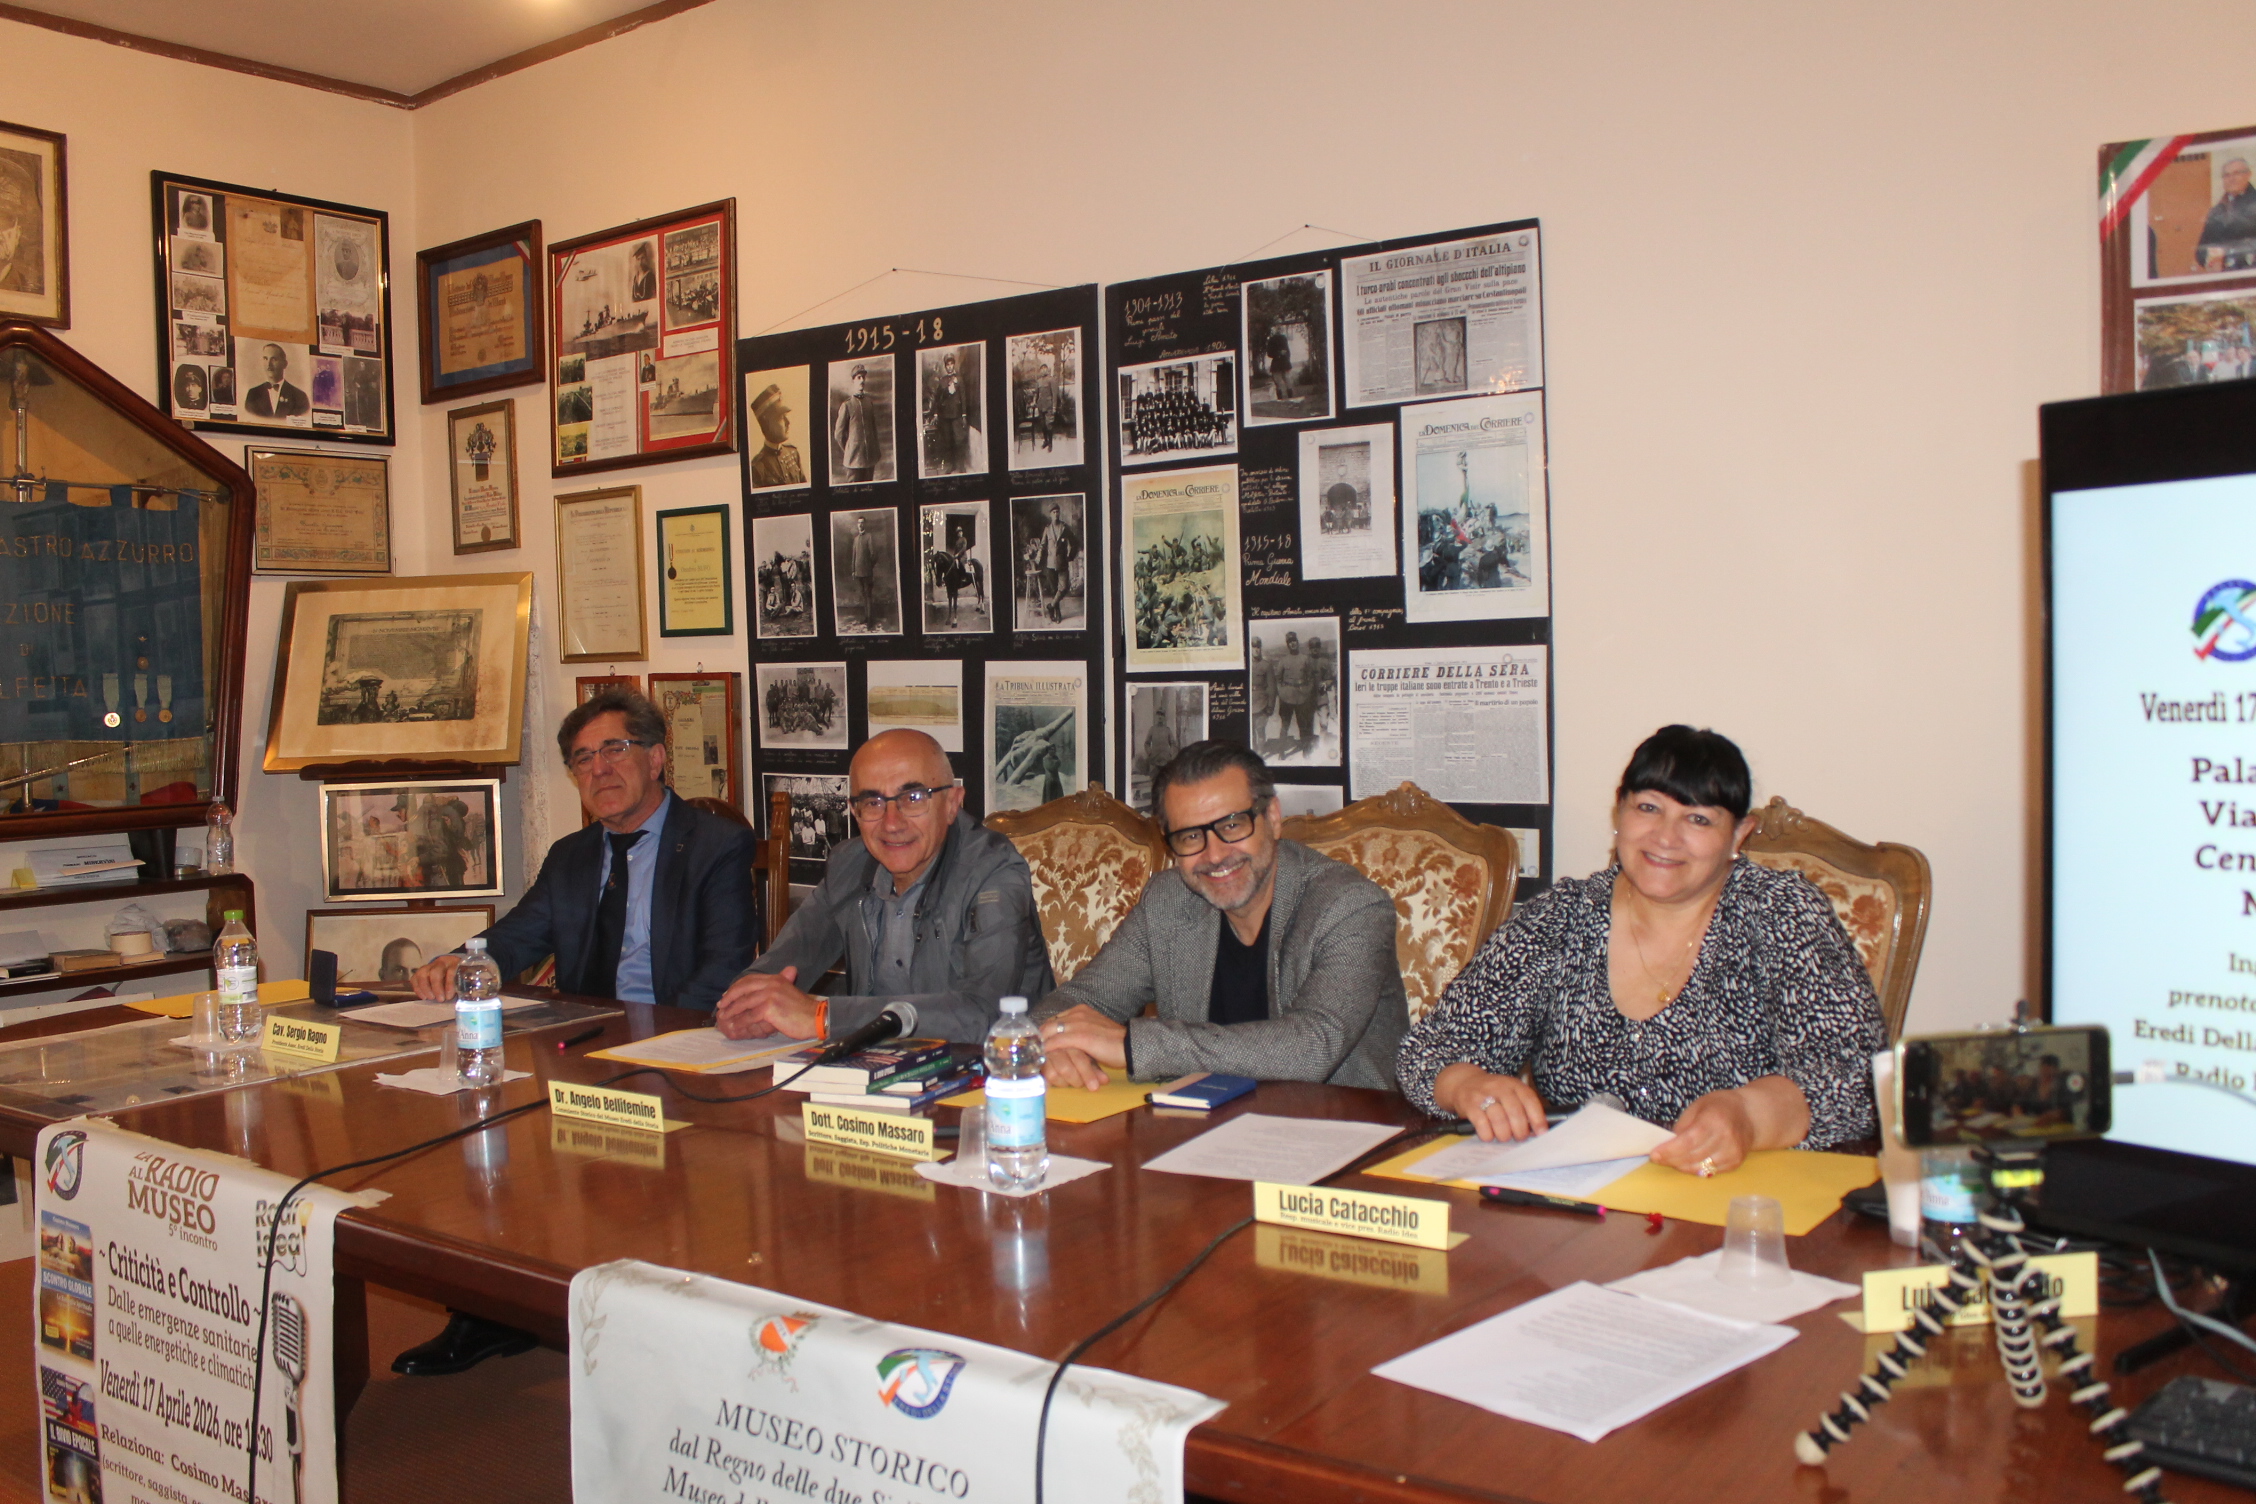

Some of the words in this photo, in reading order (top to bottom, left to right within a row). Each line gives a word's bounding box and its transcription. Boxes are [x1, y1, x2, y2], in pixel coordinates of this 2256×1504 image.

[1369, 261, 1382, 272] IL
[1386, 250, 1450, 270] GIORNALE
[1454, 242, 1512, 261] D'ITALIA
[1374, 293, 1409, 304] autentiche
[80, 540, 195, 564] AZZURRO
[1242, 552, 1265, 566] Prima
[1267, 552, 1294, 571] Guerra
[1245, 569, 1292, 586] Mondiale
[1355, 681, 1368, 692] Ieri
[1368, 681, 1376, 691] le
[1376, 682, 1399, 693] truppe
[1400, 680, 1425, 691] italiane
[1426, 681, 1442, 690] sono
[1443, 680, 1469, 690] entrate
[1475, 679, 1499, 689] Trento
[1512, 678, 1539, 688] Trieste
[1361, 667, 1431, 680] CORRIERE
[1436, 665, 1484, 678] DELLA
[1489, 664, 1530, 677] SERA
[1518, 699, 1539, 707] popolo
[2140, 692, 2227, 723] Venerdì
[2235, 692, 2256, 723] 17
[2199, 800, 2256, 828] Via
[272, 1022, 285, 1037] Cav.
[286, 1024, 307, 1041] Sergio
[307, 1028, 328, 1045] Ragno
[2133, 1018, 2195, 1044] Eredi
[2203, 1027, 2256, 1053] Dell
[554, 1088, 569, 1105] Dr.
[570, 1091, 601, 1109] Angelo
[603, 1096, 656, 1119] Bellifemine
[811, 1111, 835, 1129] Dott.
[837, 1115, 875, 1135] Cosimo
[878, 1121, 925, 1144] Massaro
[134, 1151, 153, 1163] LA
[871, 1140, 898, 1151] Politiche
[898, 1145, 930, 1156] Monetarie
[128, 1165, 144, 1181] AL
[143, 1156, 220, 1202] RADIO
[127, 1179, 216, 1235] MUSEO
[1279, 1189, 1324, 1216] Lucia
[1330, 1197, 1419, 1229] Catacchio
[179, 1227, 218, 1251] incontro
[1300, 1215, 1333, 1227] musicale
[1341, 1220, 1356, 1230] vice
[1358, 1224, 1375, 1234] pres.
[1377, 1226, 1401, 1237] Radio
[1402, 1229, 1419, 1238] Idea
[43, 1270, 67, 1290] SCONTRO
[68, 1280, 93, 1299] GLOBALE
[108, 1240, 166, 1296] Criticità
[168, 1271, 177, 1299] e
[179, 1266, 250, 1327] Controllo
[108, 1284, 136, 1316] Dalle
[138, 1302, 200, 1341] emergenze
[202, 1327, 258, 1364] sanitarie
[108, 1317, 115, 1335] a
[116, 1320, 143, 1348] quelle
[144, 1332, 199, 1370] energetiche
[200, 1355, 206, 1372] e
[207, 1353, 256, 1392] climatich
[100, 1358, 140, 1408] Venerdì
[142, 1376, 156, 1412] 17
[156, 1382, 191, 1428] Aprile
[193, 1396, 223, 1448] 2026,
[224, 1418, 243, 1450] ore
[101, 1423, 165, 1465] Relaziona:
[171, 1453, 219, 1489] Cosimo
[715, 1399, 824, 1456] MUSEO
[831, 1433, 970, 1500] STORICO
[102, 1454, 146, 1488] (scrittore,
[669, 1428, 700, 1460] dal
[704, 1437, 766, 1486] Regno
[772, 1460, 819, 1497] delle
[824, 1478, 863, 1504] due
